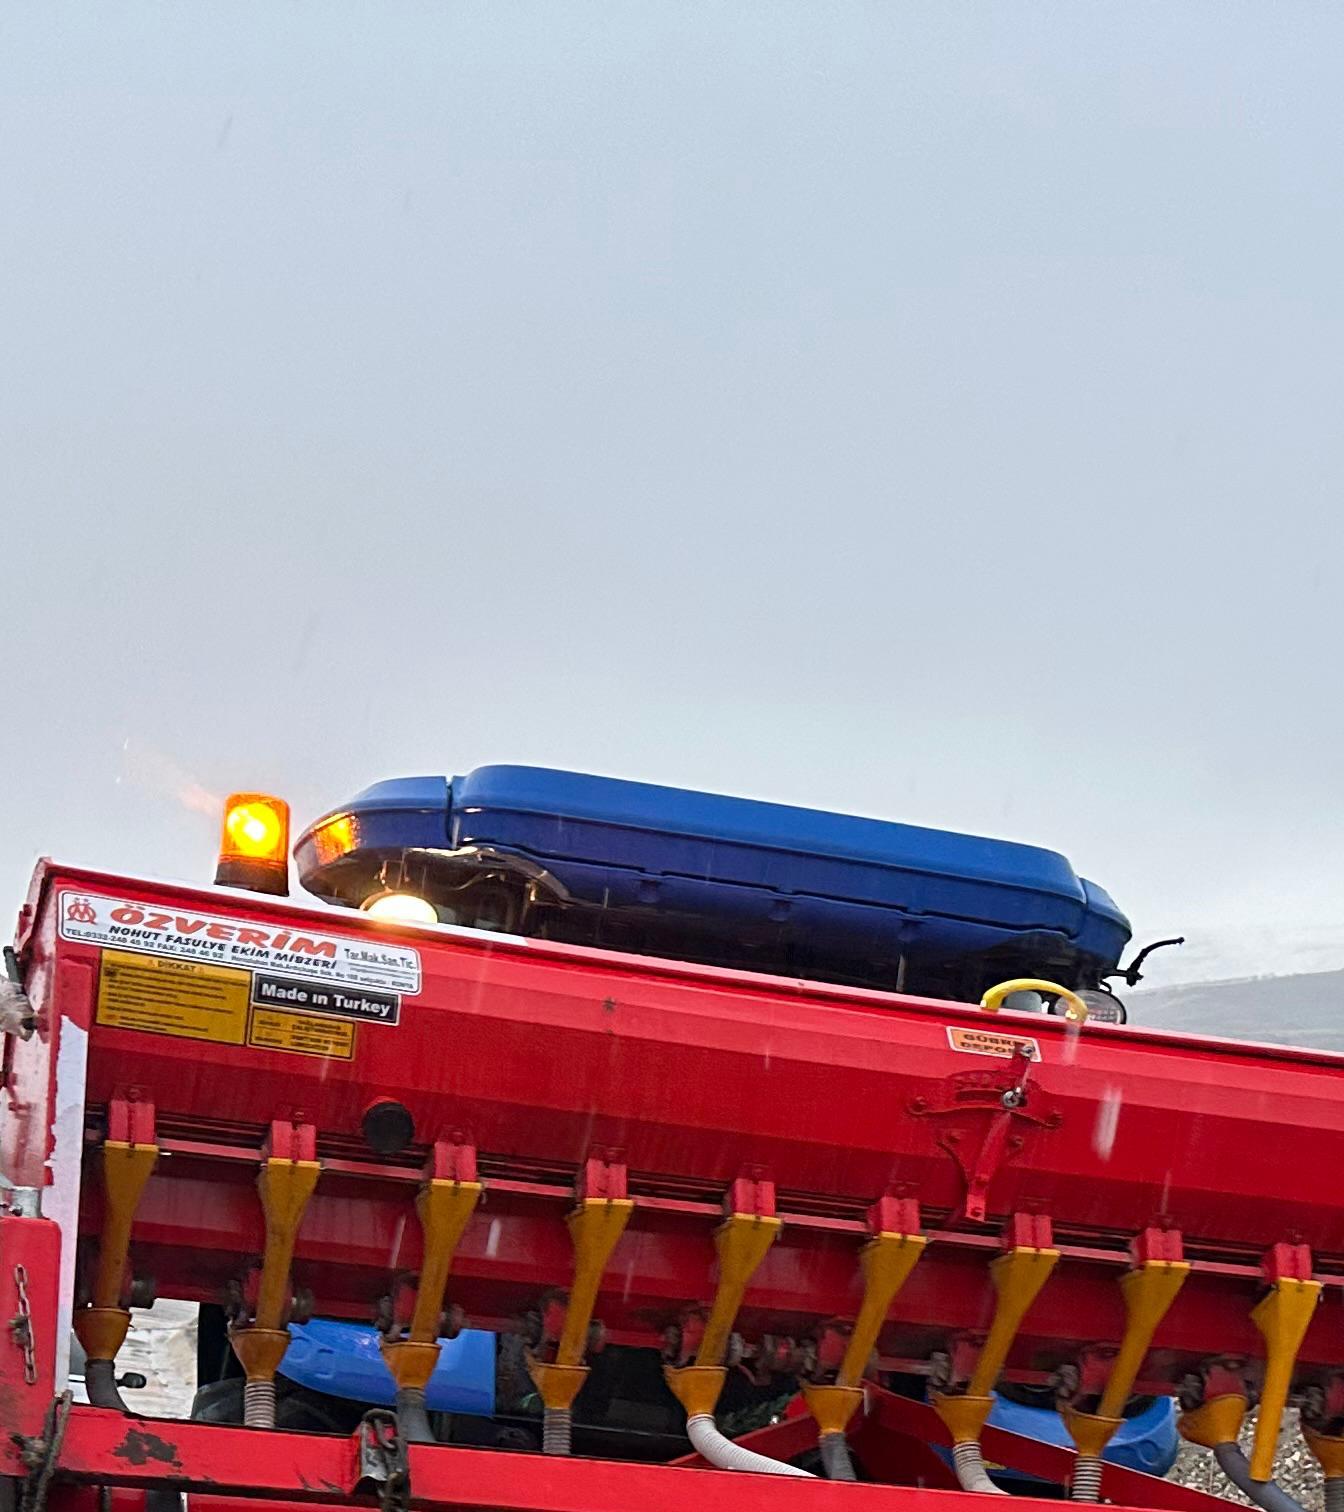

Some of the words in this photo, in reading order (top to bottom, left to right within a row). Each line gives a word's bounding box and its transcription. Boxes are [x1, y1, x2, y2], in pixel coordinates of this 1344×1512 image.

[109, 926, 162, 941] NOHUT
[165, 934, 227, 951] FASULYE
[231, 945, 269, 959] EKİM
[274, 953, 337, 970] MİBZERİ
[110, 904, 337, 959] ÖZVERİM
[261, 983, 308, 1002] Made
[333, 994, 391, 1017] Turkey
[960, 1041, 1016, 1053] DEPO
